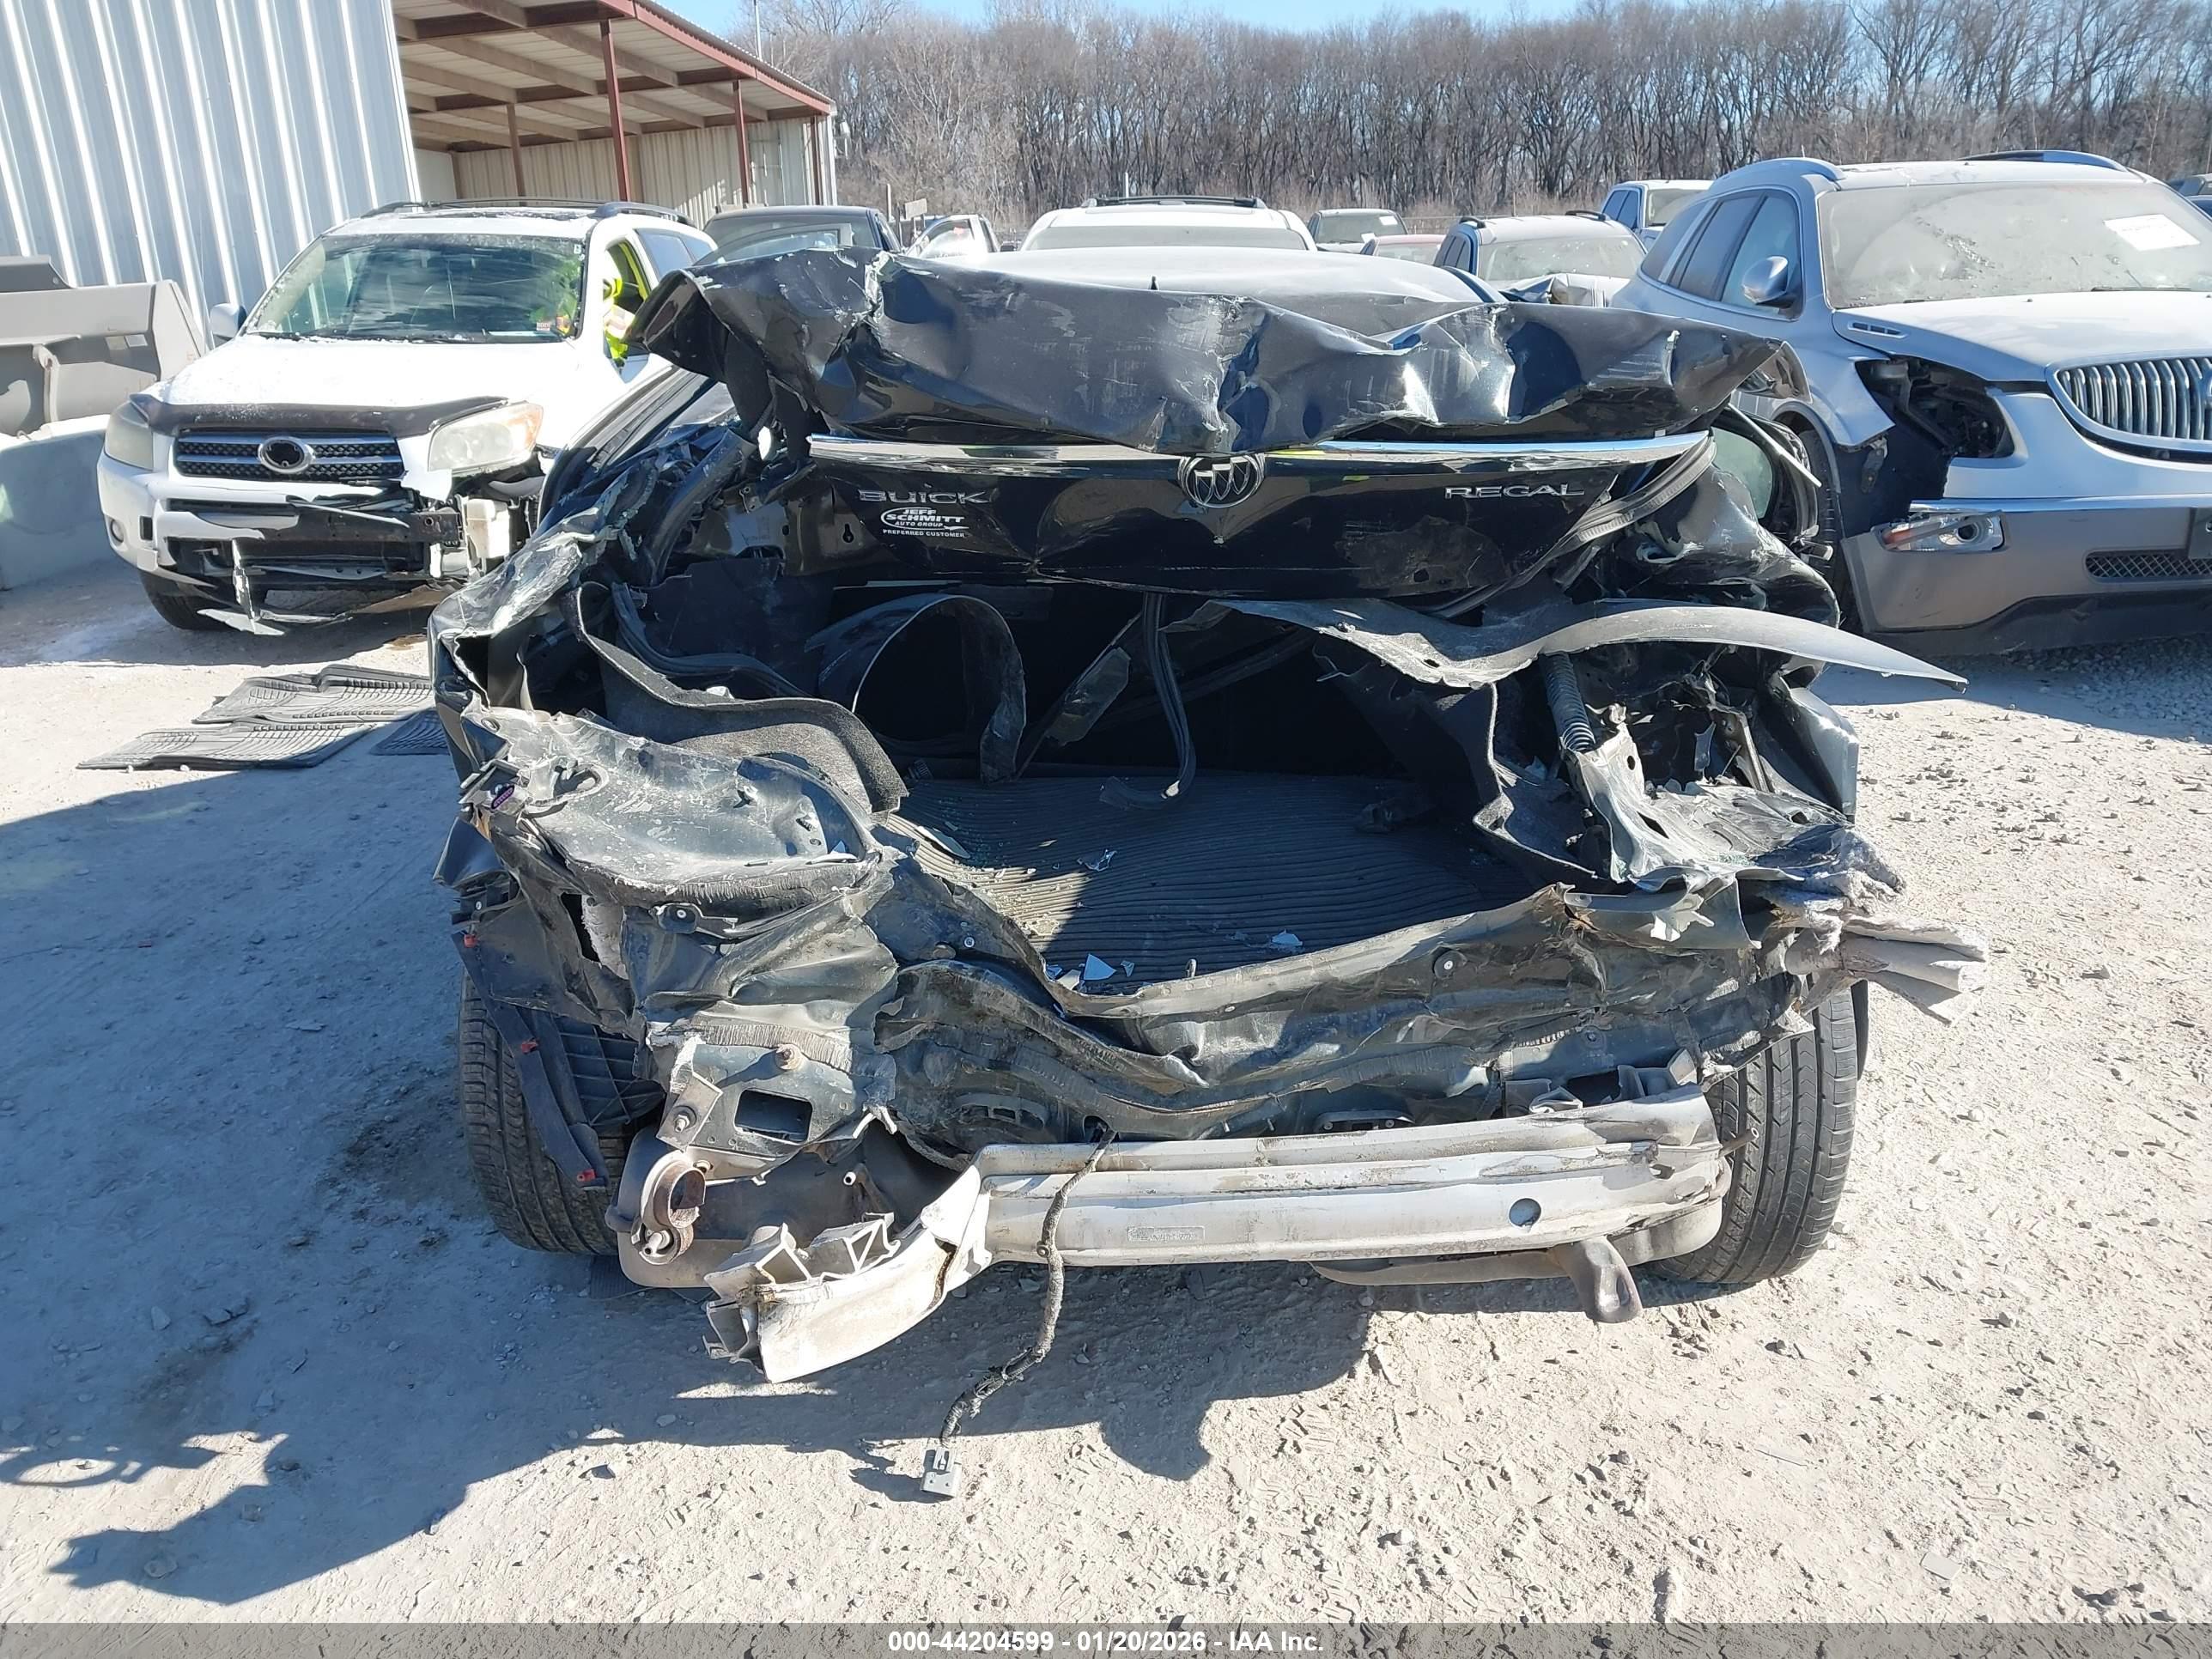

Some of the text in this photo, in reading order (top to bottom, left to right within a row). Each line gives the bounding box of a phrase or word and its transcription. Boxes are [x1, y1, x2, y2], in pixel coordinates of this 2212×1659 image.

[859, 489, 989, 505] BUICK
[1444, 483, 1585, 500] REGAL
[885, 514, 965, 523] SCHMITT
